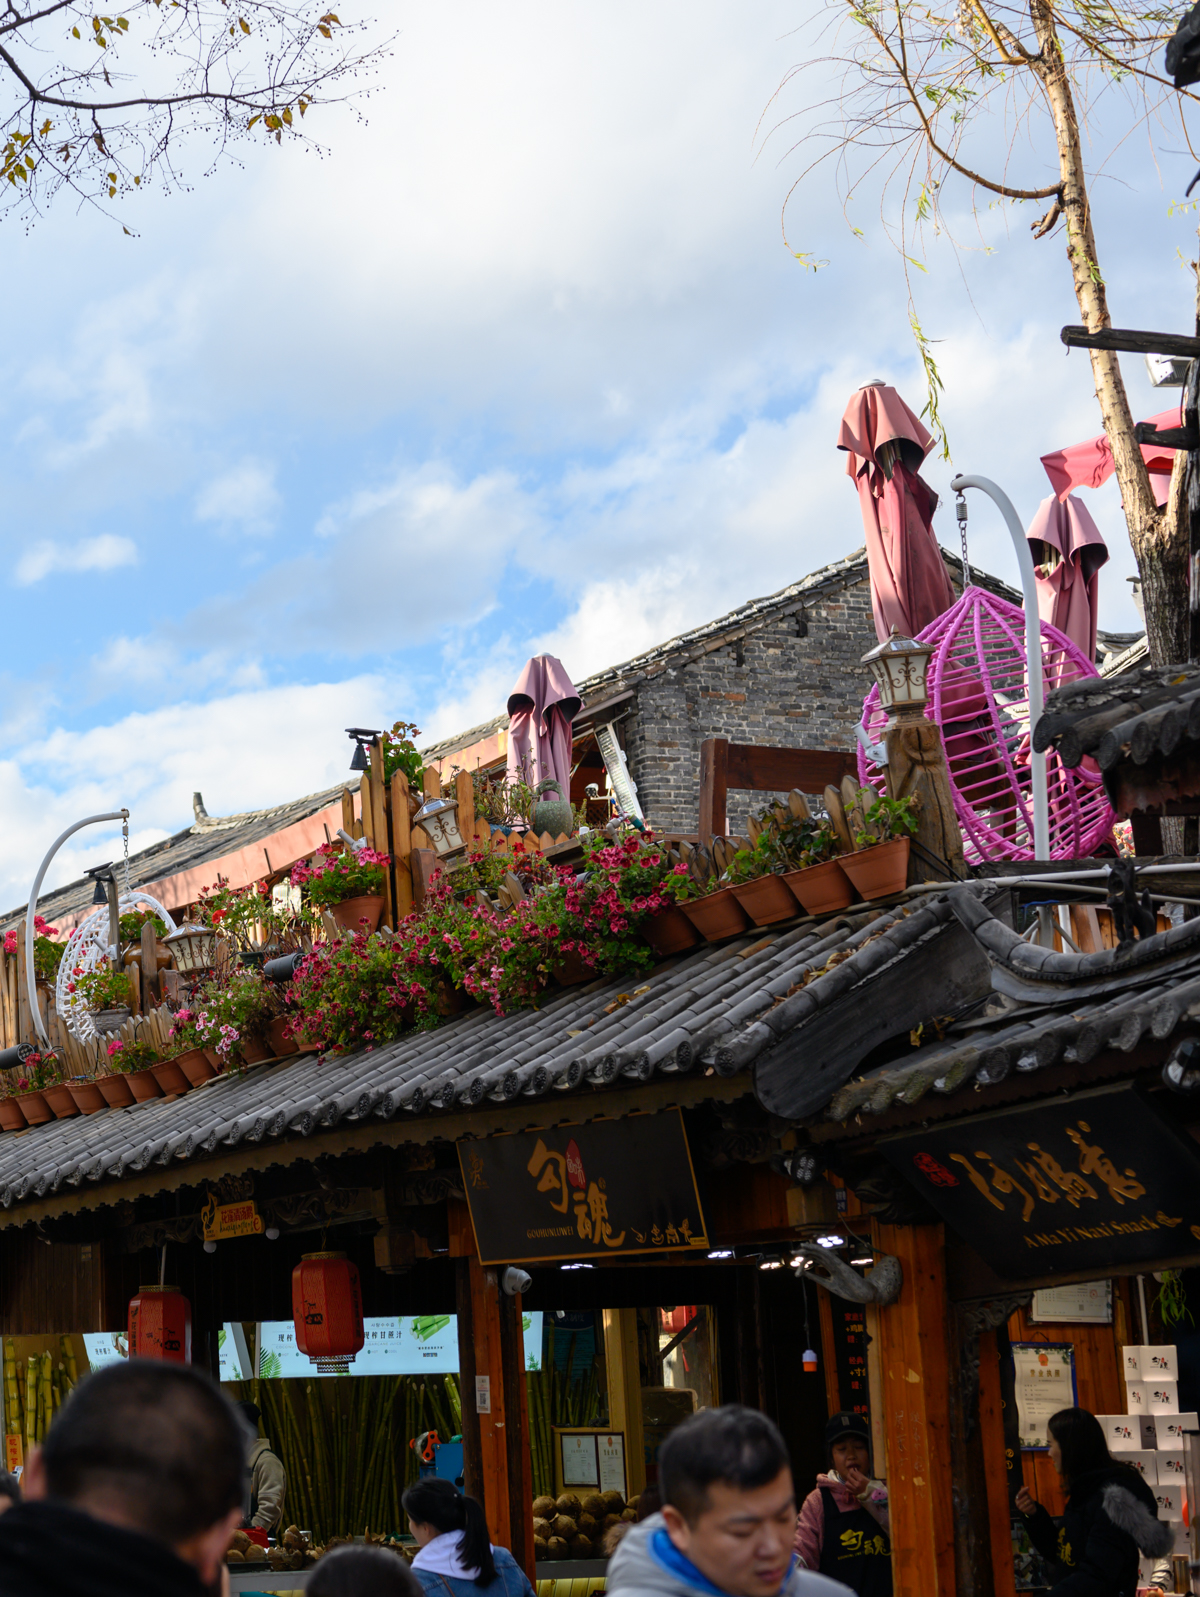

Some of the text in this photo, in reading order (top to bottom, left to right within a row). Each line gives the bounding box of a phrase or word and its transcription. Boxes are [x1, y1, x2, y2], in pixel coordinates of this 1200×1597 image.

[527, 1137, 626, 1248] 勾魂
[1023, 1215, 1161, 1248] A Ma Yi Naxi Snack
